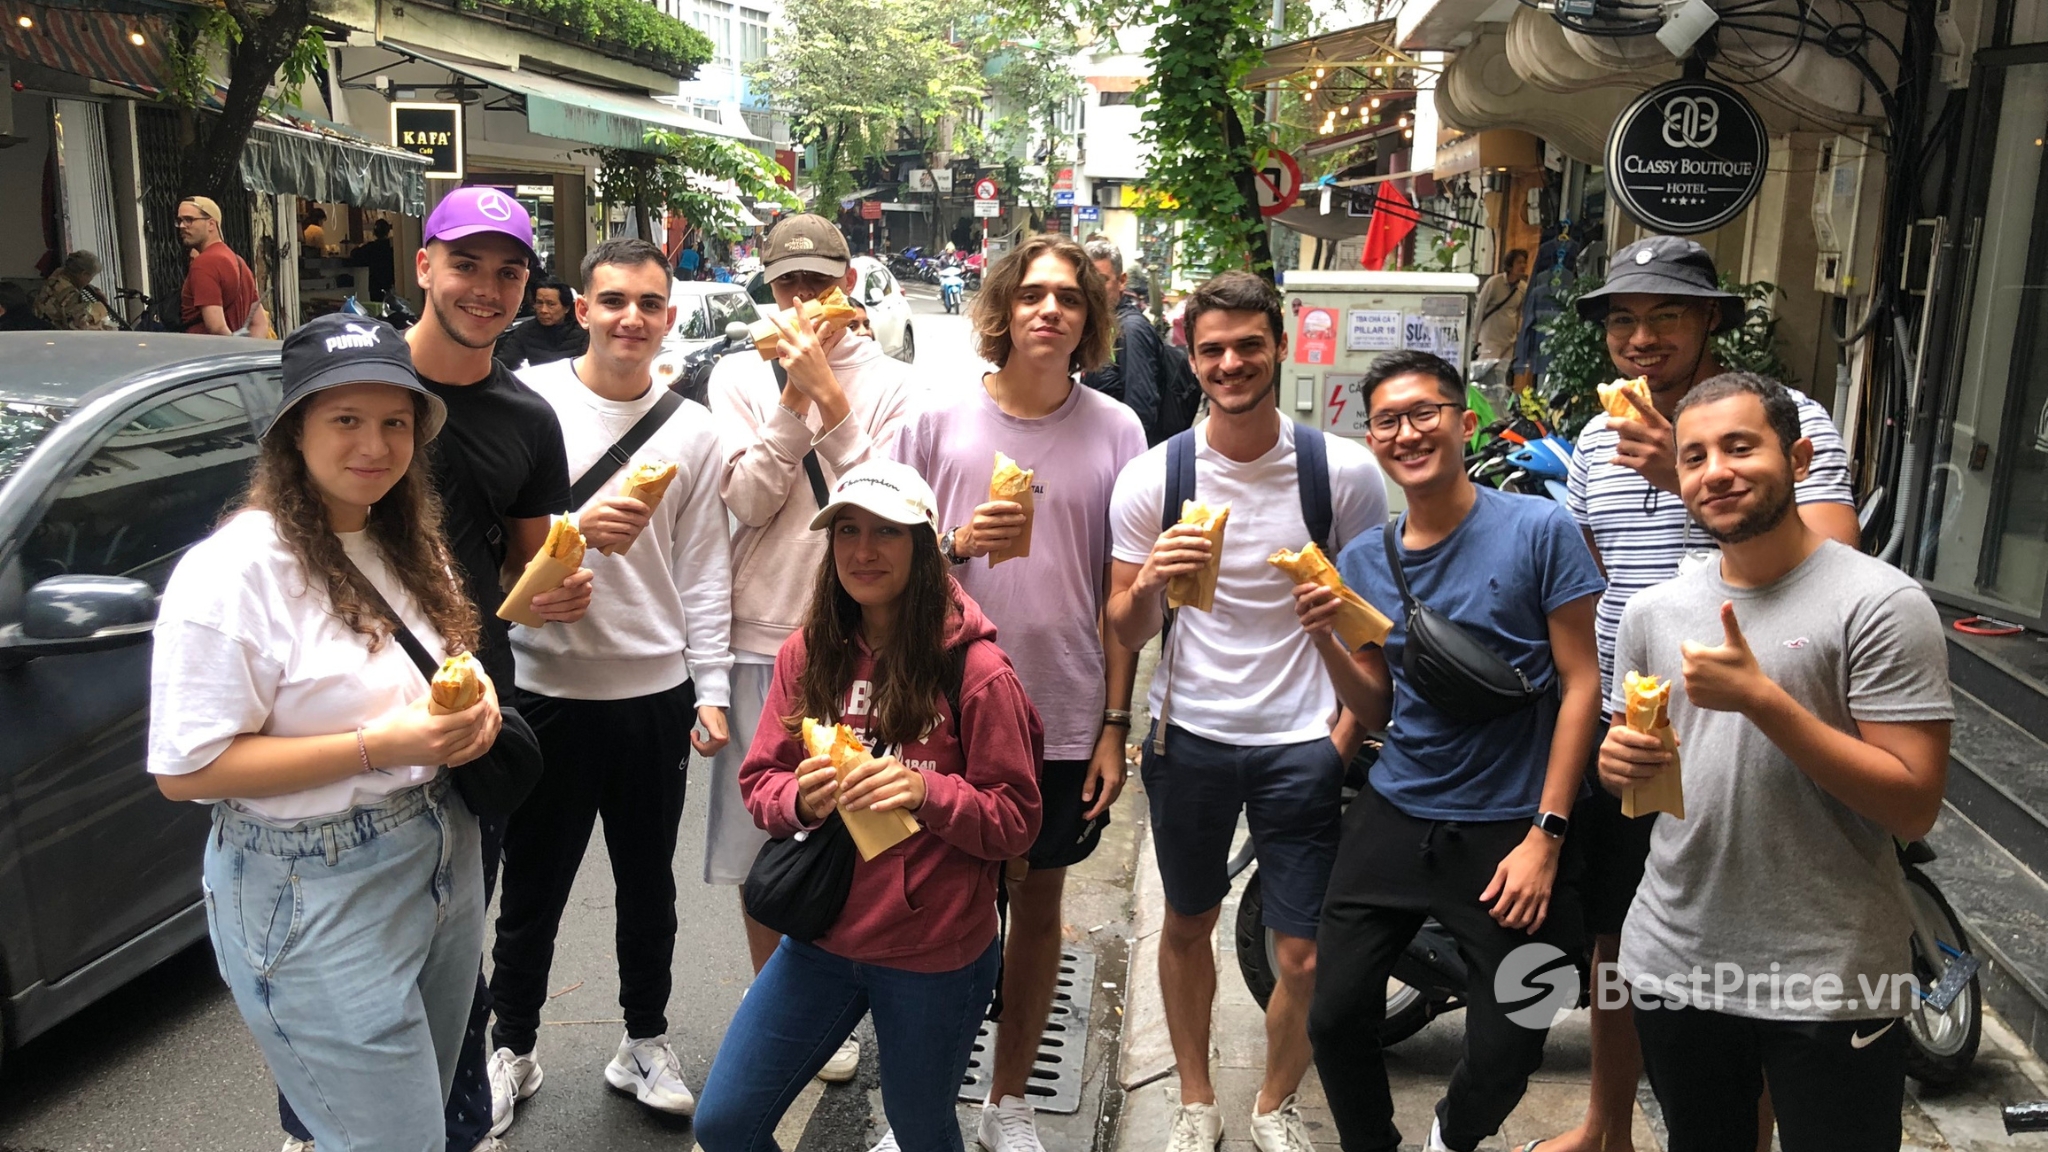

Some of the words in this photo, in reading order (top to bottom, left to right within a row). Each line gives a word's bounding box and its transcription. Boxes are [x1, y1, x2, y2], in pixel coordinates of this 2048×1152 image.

[1666, 182, 1708, 195] HOTEL
[1354, 326, 1384, 335] PILLAR
[325, 334, 374, 353] PUMA
[837, 478, 900, 493] Champion
[1031, 485, 1044, 494] TAL
